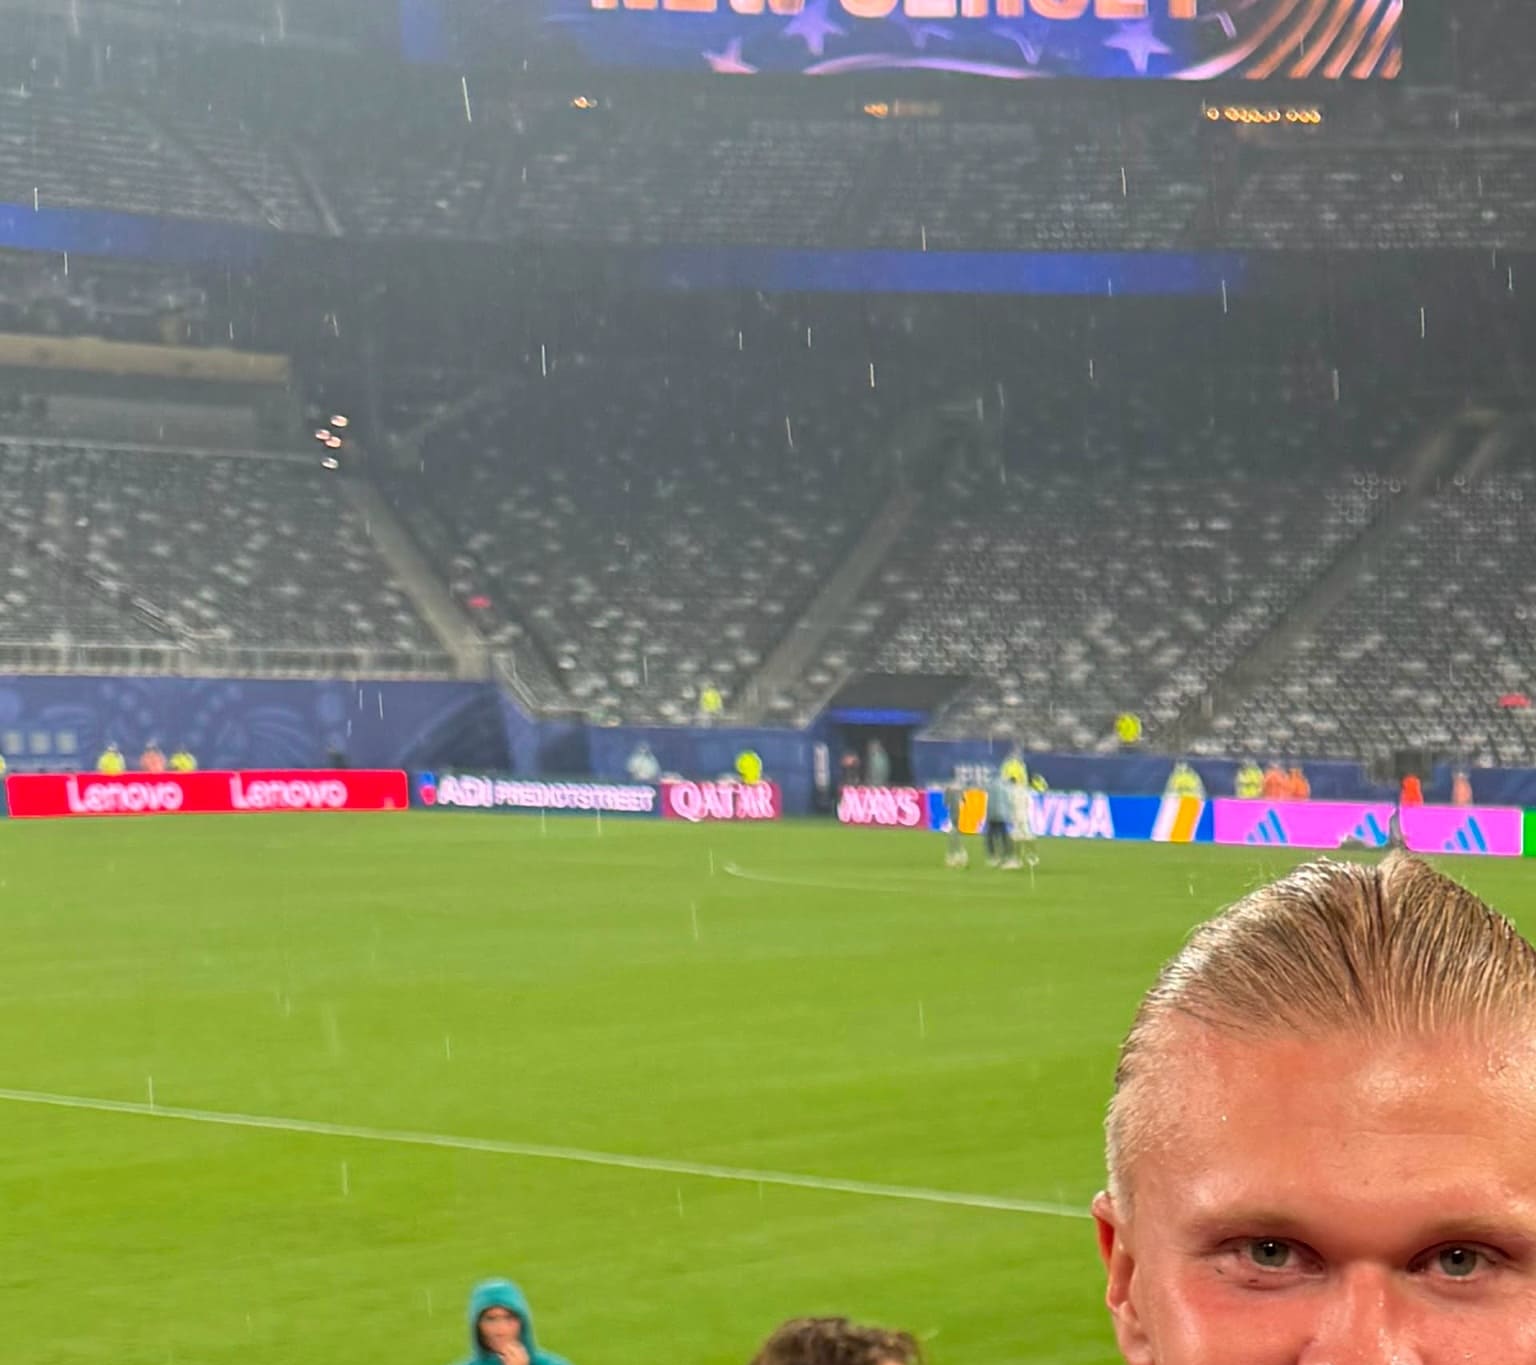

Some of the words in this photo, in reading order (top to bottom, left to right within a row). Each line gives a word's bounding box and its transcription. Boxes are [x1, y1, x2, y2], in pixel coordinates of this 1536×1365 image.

[66, 775, 184, 813] Lenovo
[229, 772, 348, 810] Lenovo
[669, 780, 776, 822] QATAR
[1027, 790, 1115, 839] VISA
